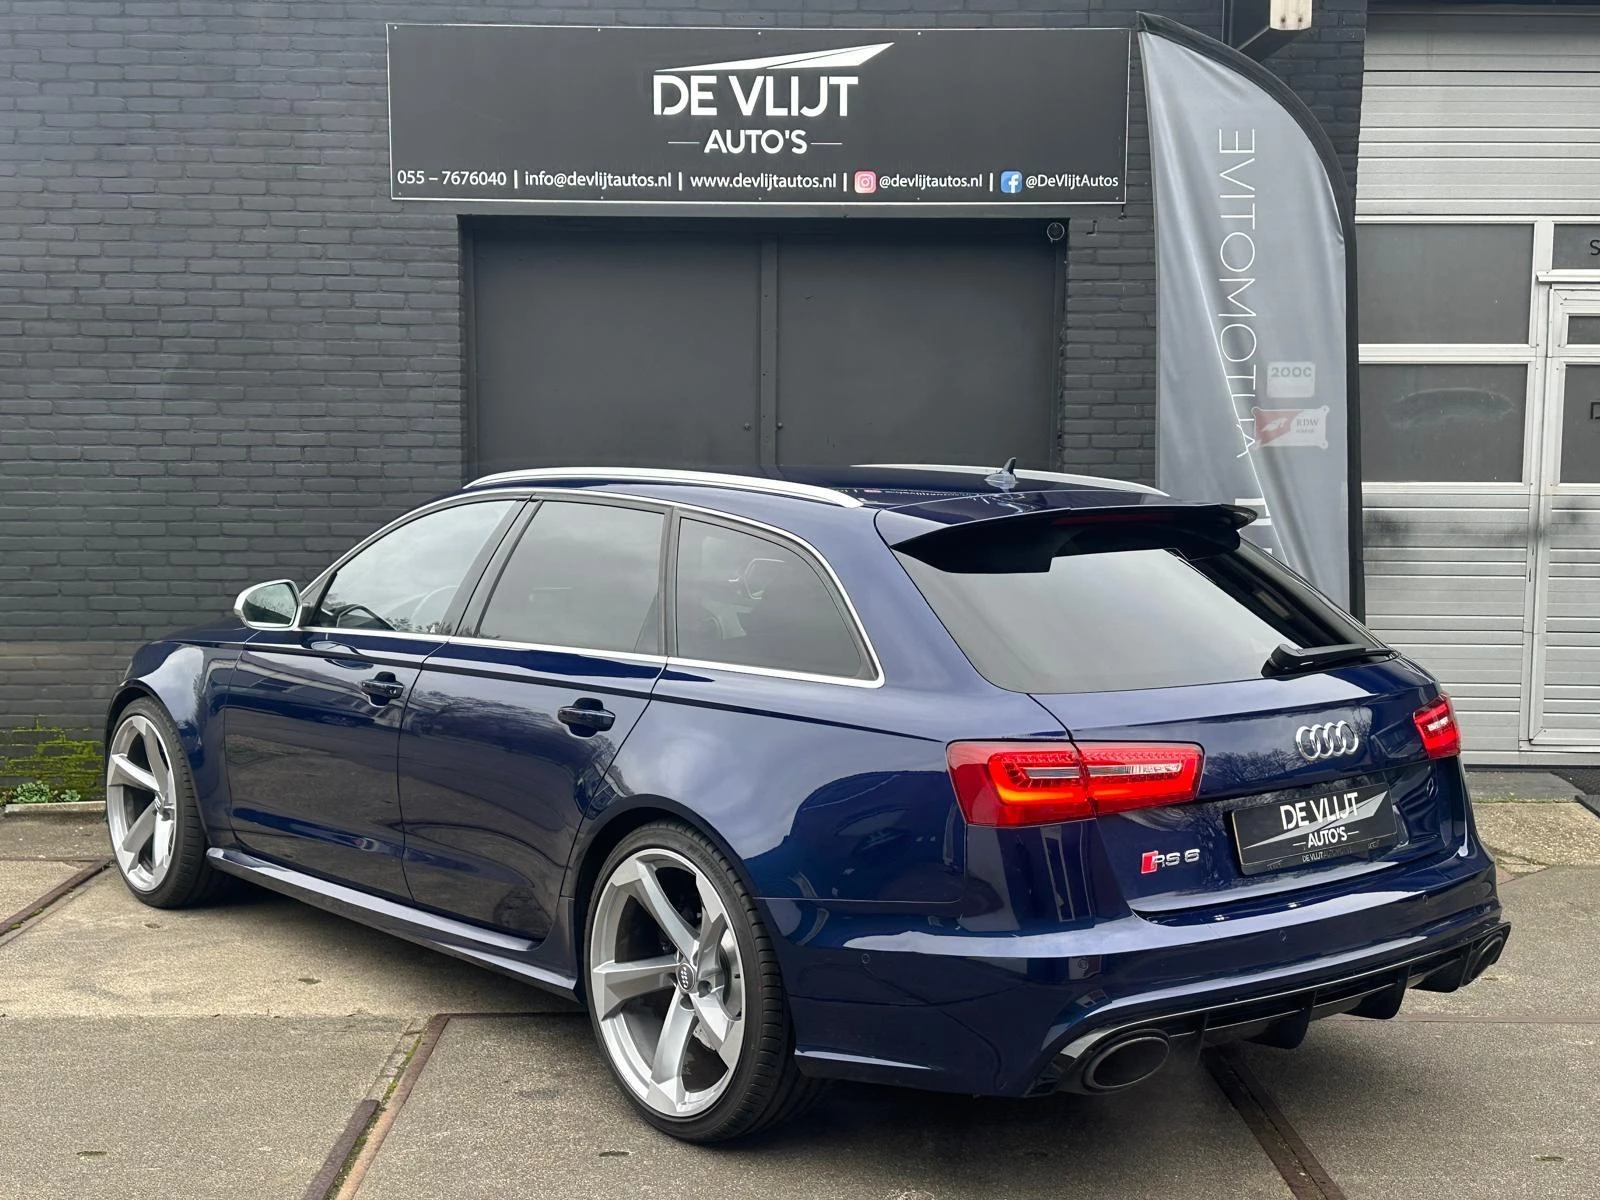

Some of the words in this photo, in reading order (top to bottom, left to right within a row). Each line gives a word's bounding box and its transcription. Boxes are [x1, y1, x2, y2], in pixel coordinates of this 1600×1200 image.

[653, 75, 718, 116] DE
[729, 75, 859, 117] VLIJT
[703, 129, 808, 153] AUTO'S
[397, 170, 425, 185] 055
[442, 170, 507, 186] 7676040
[525, 170, 672, 190] info@devlijtautos.nl
[690, 172, 837, 192] www.devlijtautos.nl
[879, 173, 983, 193] @devlijtautos.nl
[1025, 173, 1119, 193] @DeVlijtAutos
[1280, 801, 1309, 831] DE
[1310, 792, 1358, 824] VLIJT
[1307, 826, 1348, 849] AUTO'S
